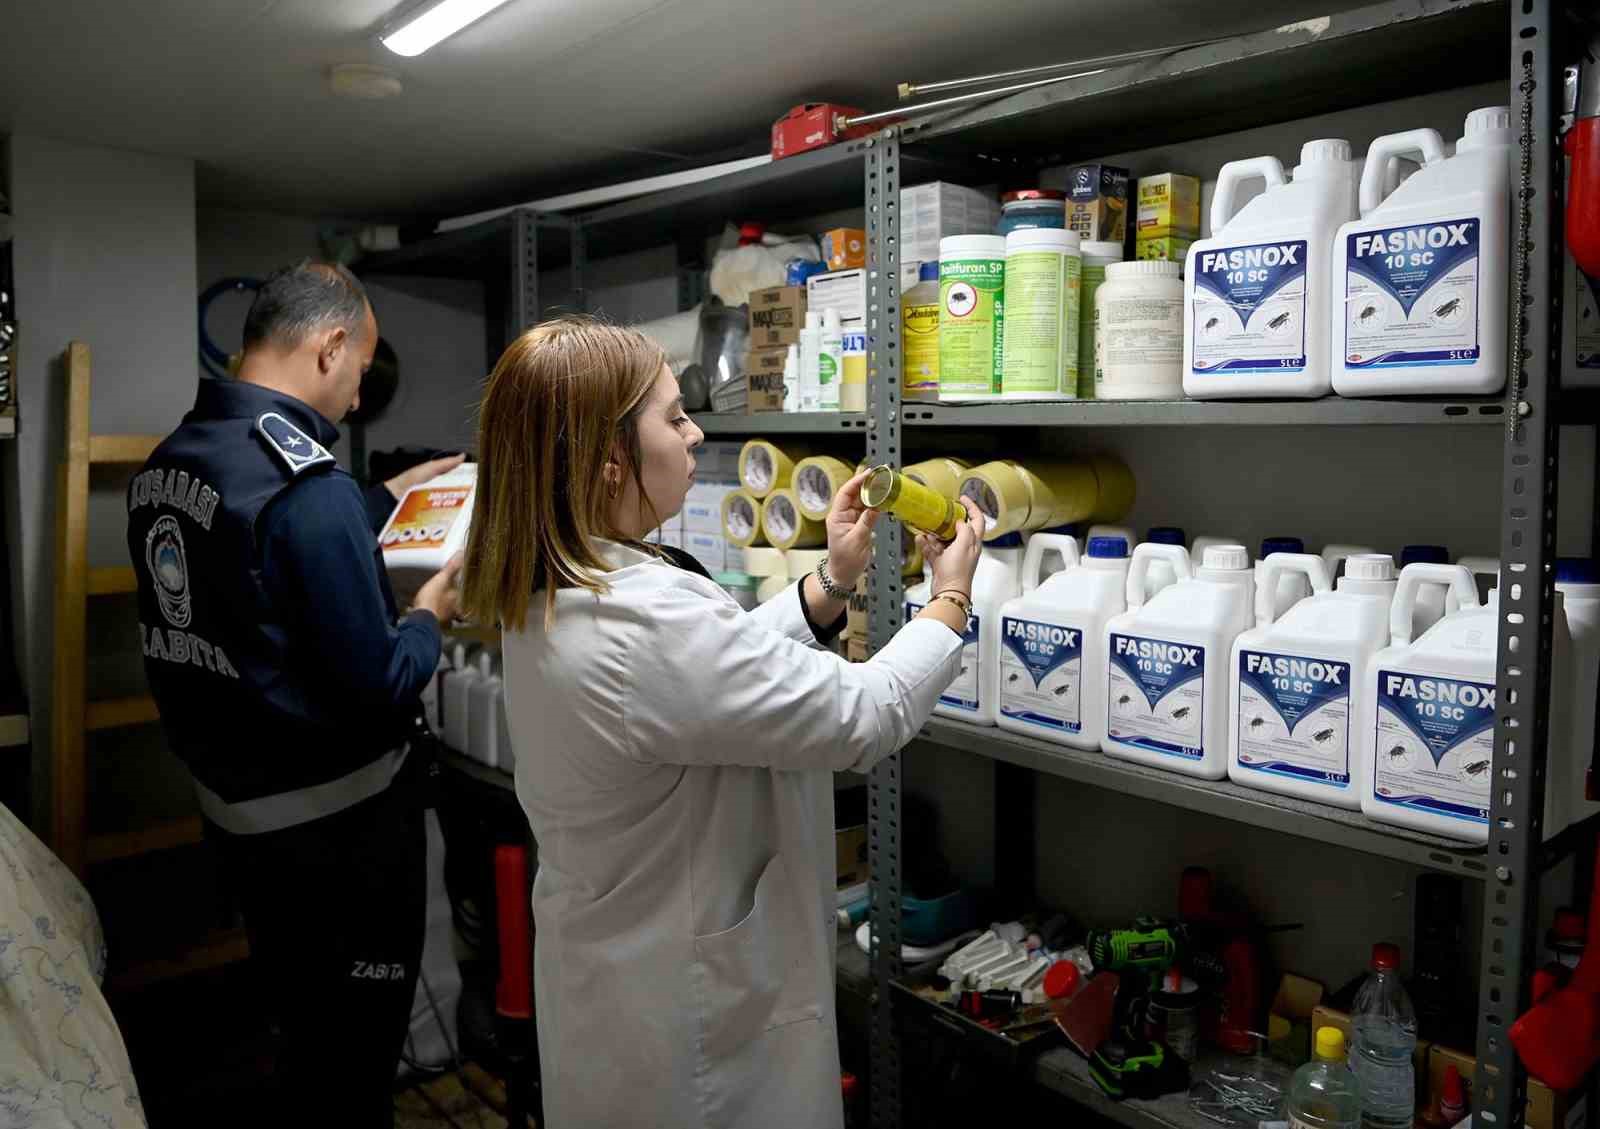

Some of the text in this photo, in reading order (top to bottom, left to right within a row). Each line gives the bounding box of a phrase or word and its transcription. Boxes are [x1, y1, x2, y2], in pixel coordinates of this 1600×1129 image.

[1356, 223, 1469, 258] FASNOX
[989, 262, 1003, 274] SP
[1202, 245, 1298, 273] FASNOX
[1385, 252, 1434, 269] 10 SC
[1227, 269, 1269, 284] 10 SC
[1007, 620, 1077, 648] FASNOX
[1023, 641, 1055, 656] 10 SC
[1116, 637, 1198, 667] FASNOX
[1136, 658, 1173, 675] 10 SC
[1247, 654, 1342, 684] FASNOX
[1271, 677, 1313, 694] 10 SC
[1387, 675, 1496, 710] FASNOX
[1415, 702, 1465, 720] 10 SC
[350, 961, 405, 979] ZABITA
